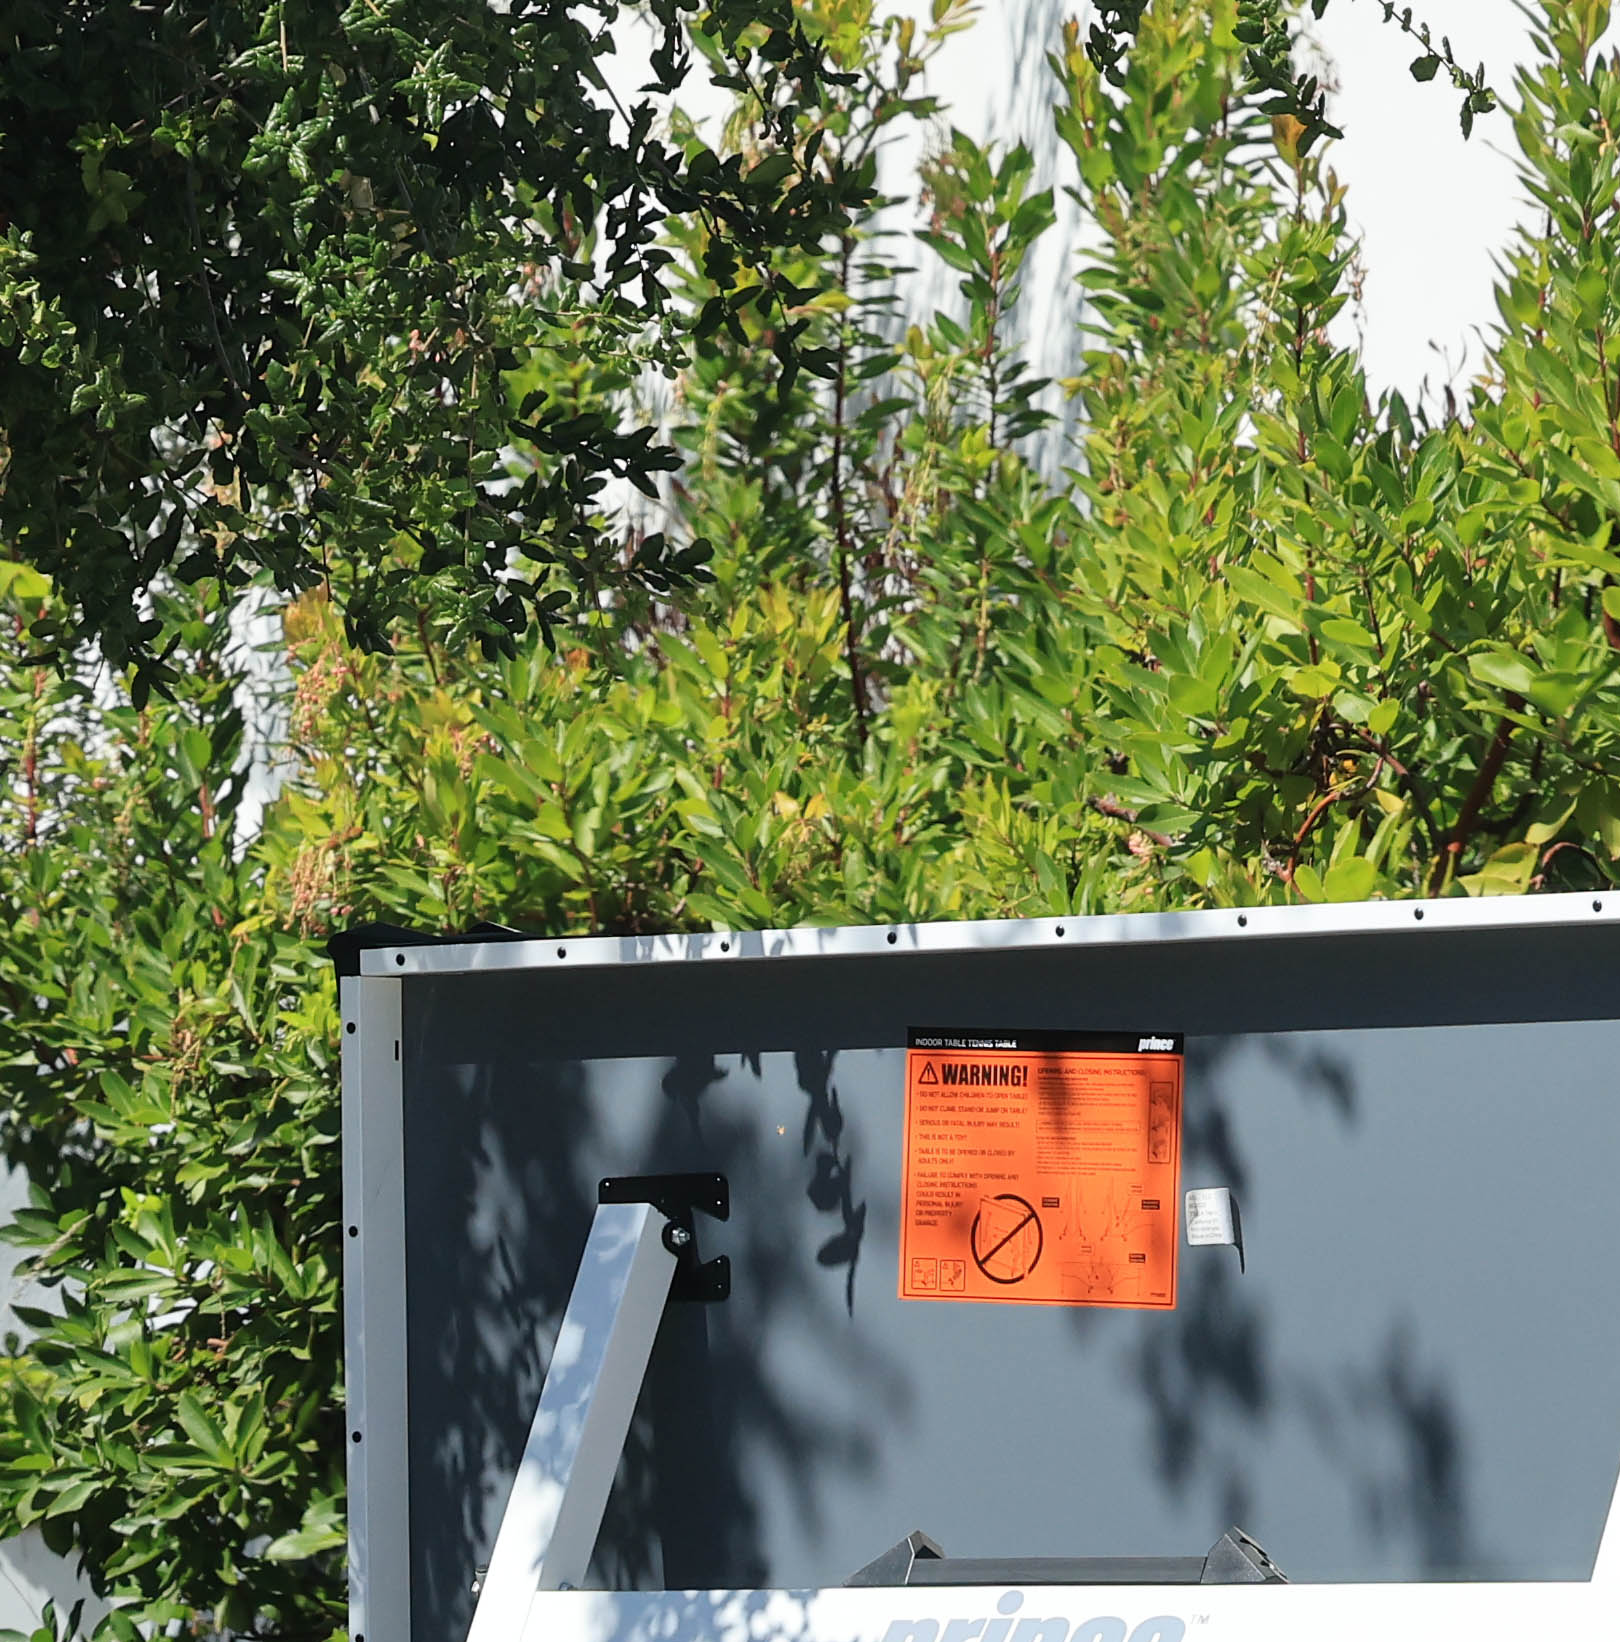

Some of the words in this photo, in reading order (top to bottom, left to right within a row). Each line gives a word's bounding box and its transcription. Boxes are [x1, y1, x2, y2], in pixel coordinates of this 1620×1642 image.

[915, 1038, 942, 1047] INDOOR
[944, 1038, 966, 1048] TABLE
[968, 1039, 993, 1049] TENNIS
[995, 1039, 1017, 1049] TABLE
[1137, 1035, 1174, 1052] prince
[941, 1063, 1028, 1087] WARNING!
